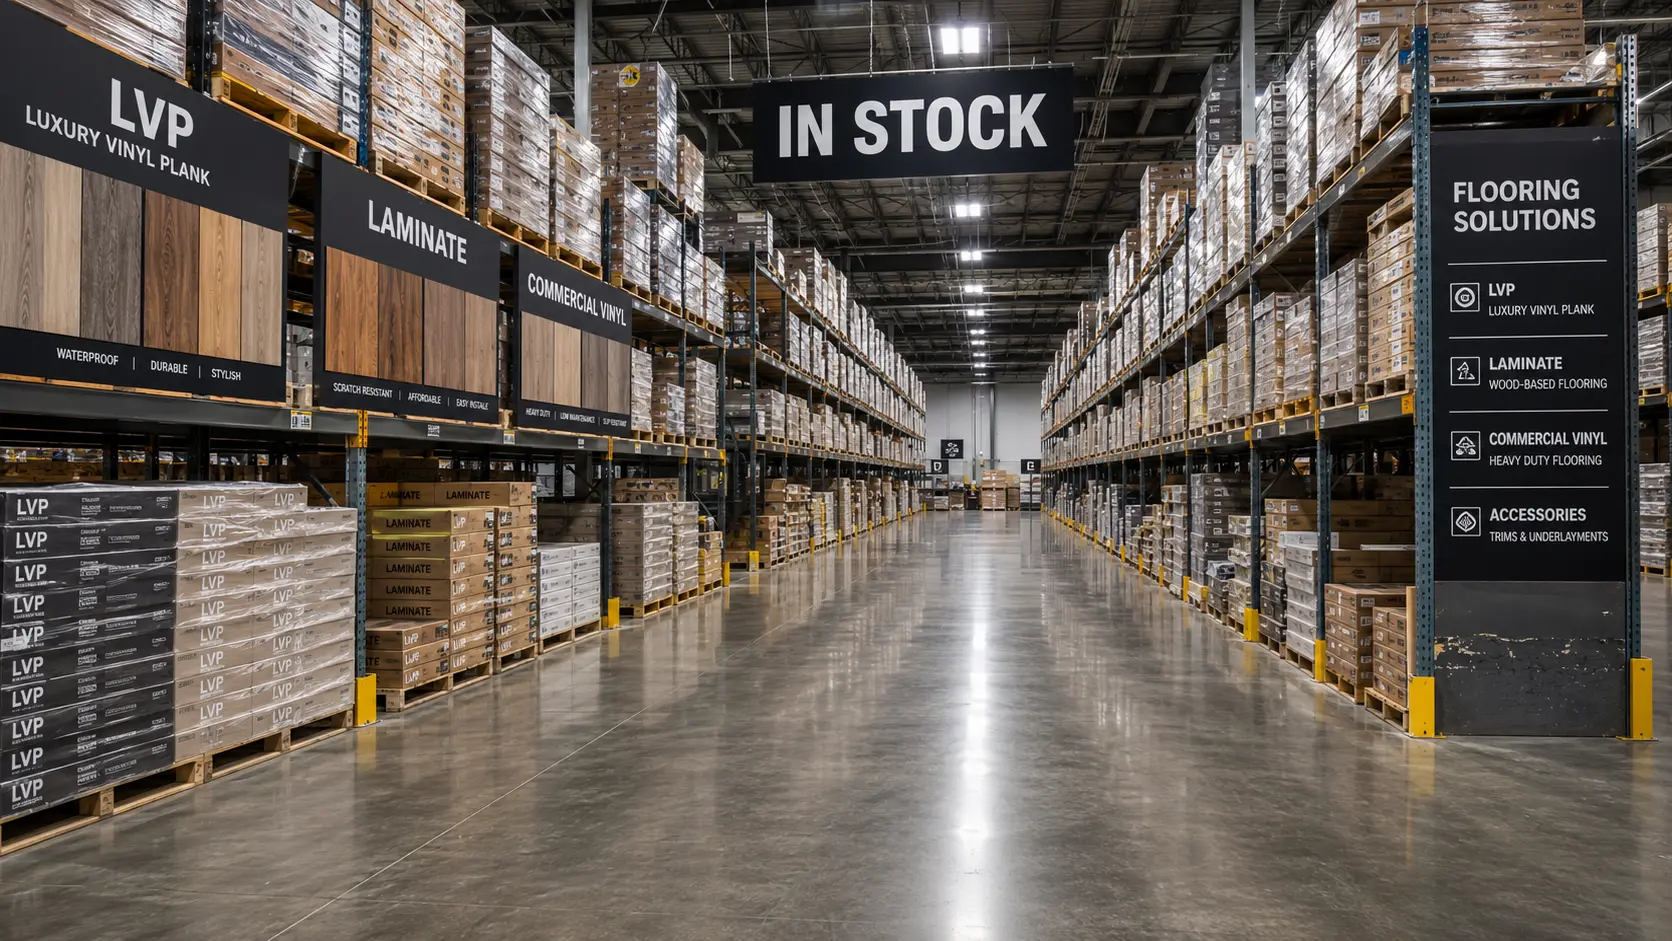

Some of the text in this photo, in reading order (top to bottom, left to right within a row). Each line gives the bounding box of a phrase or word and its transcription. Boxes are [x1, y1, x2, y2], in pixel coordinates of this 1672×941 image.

[110, 78, 194, 148] LVP
[779, 93, 1048, 158] IN STOCK
[26, 105, 210, 186] LUXURY VINYL PLANK
[1454, 179, 1580, 203] FLOORING
[1454, 207, 1596, 232] SOLUTIONS
[368, 199, 467, 265] LAMINATE
[1488, 283, 1516, 296] LVP
[528, 272, 626, 326] COMMERCIAL VINYL
[1488, 304, 1594, 316] LUXURY VINYL PLANK
[56, 348, 241, 381] WATERPROOF DURABLE STYLISH
[1489, 356, 1563, 370] LAMINATE
[1489, 378, 1607, 390] WOOD-BASED FLOORING
[1489, 432, 1607, 446] COMMERCIAL VINYL
[1490, 455, 1602, 465] HEAVY DUTY FLOORING
[203, 496, 226, 509] LVP
[275, 493, 295, 506] LVP
[446, 491, 490, 499] LAMINATE
[17, 498, 48, 516] LVP
[1490, 508, 1586, 522] ACCESSORIES
[203, 524, 226, 537] LVP
[274, 519, 295, 531] LVP
[386, 519, 431, 528] LAMINATE
[16, 531, 47, 548] LVP
[1490, 531, 1608, 542] TRIMS & UNDERLAYMENTS
[274, 543, 292, 555] LVP
[386, 542, 431, 551] LAMINATE
[202, 550, 225, 564] LVP
[15, 564, 47, 582] LVP
[274, 567, 292, 580] LVP
[386, 564, 431, 573] LAMINATE
[201, 576, 224, 590] LVP
[386, 586, 431, 595] LAMINATE
[14, 595, 45, 613] LVP
[274, 590, 292, 604] LVP
[202, 601, 224, 616] LVP
[386, 607, 431, 615] LAMINATE
[273, 613, 292, 628] LVP
[13, 626, 44, 646] LVP
[200, 626, 223, 642] LVP
[273, 635, 292, 651] LVP
[12, 656, 43, 675] LVP
[200, 652, 224, 668] LVP
[272, 658, 292, 674] LVP
[200, 676, 224, 694] LVP
[272, 683, 292, 700] LVP
[12, 686, 44, 707] LVP
[200, 702, 223, 720] LVP
[273, 707, 292, 723] LVP
[12, 716, 44, 739] LVP
[12, 747, 43, 770] LVP
[12, 778, 43, 802] LVP
